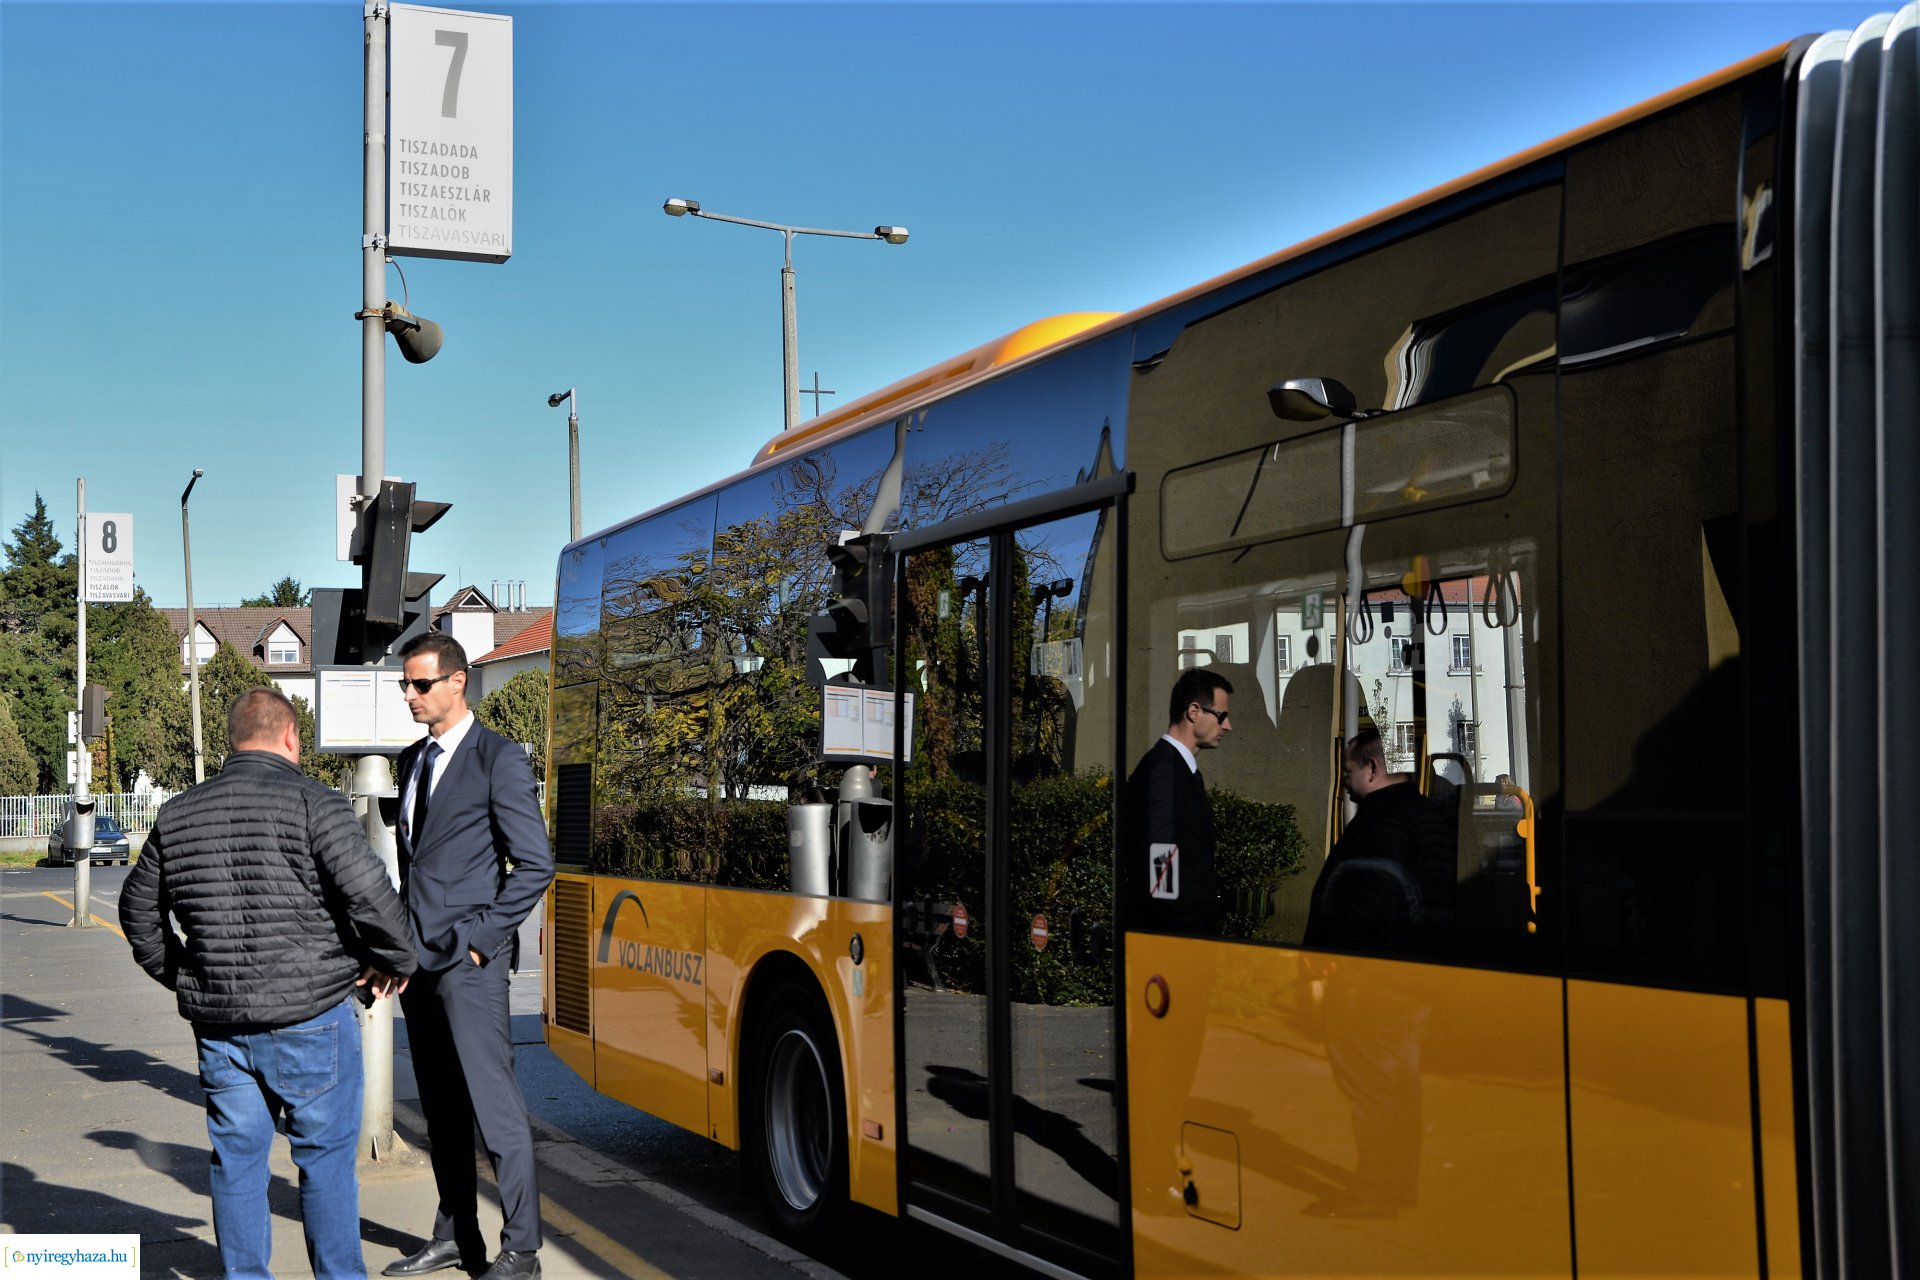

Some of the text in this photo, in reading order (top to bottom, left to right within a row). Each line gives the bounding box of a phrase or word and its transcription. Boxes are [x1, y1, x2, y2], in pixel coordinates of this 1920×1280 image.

[435, 29, 468, 118] 7
[400, 138, 479, 159] TISZADADA
[400, 160, 470, 180] TISZADOB
[400, 182, 491, 203] TISZAESZLÁR
[400, 203, 467, 222] TISZALÖK
[398, 224, 505, 247] TISZAVASVÁRI
[102, 520, 117, 554] 8
